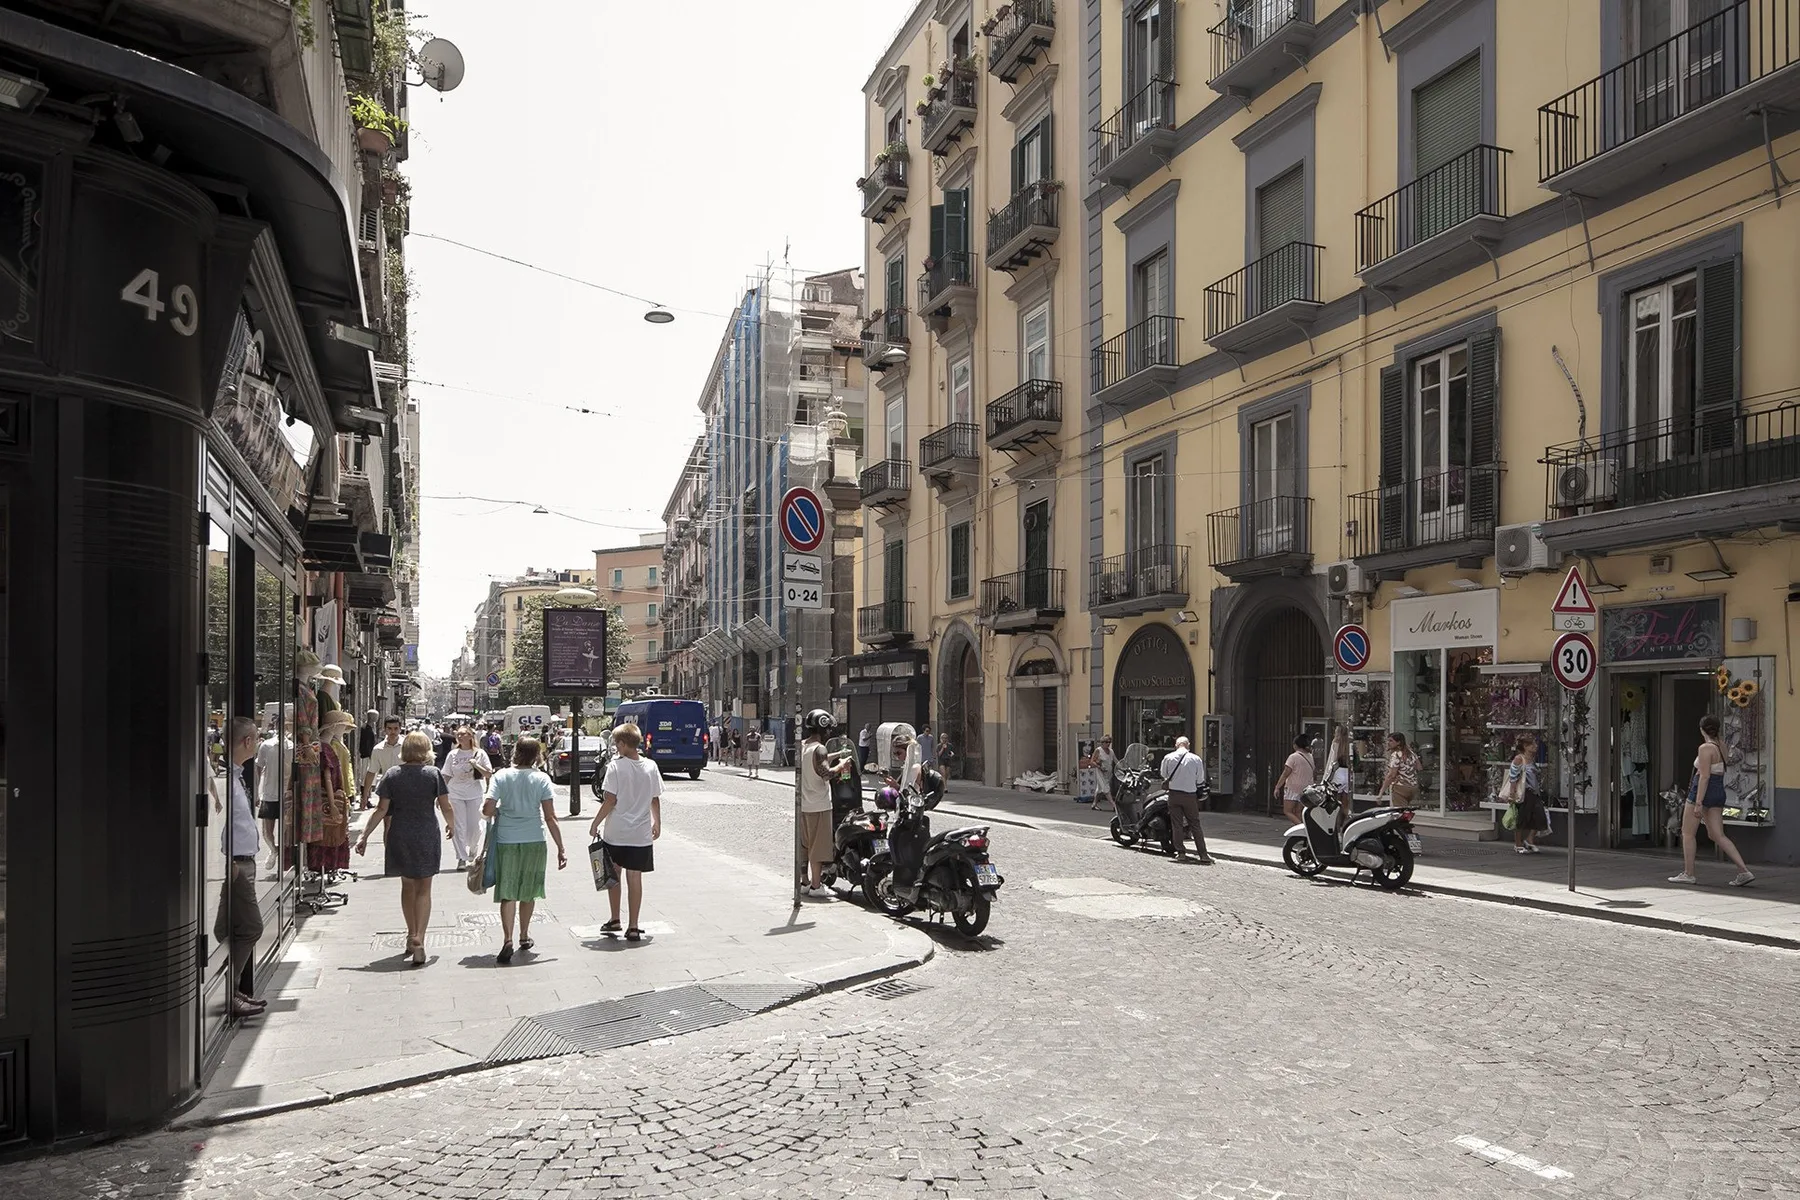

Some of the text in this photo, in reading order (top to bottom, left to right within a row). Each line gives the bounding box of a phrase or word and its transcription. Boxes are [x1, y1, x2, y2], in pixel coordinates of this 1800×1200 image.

[121, 268, 198, 336] 49
[788, 589, 818, 602] 0-24
[1409, 610, 1473, 634] Markos
[1134, 637, 1168, 655] OTTICA
[1642, 643, 1694, 653] INTIMO
[1562, 647, 1589, 674] 30
[518, 715, 543, 725] GLS
